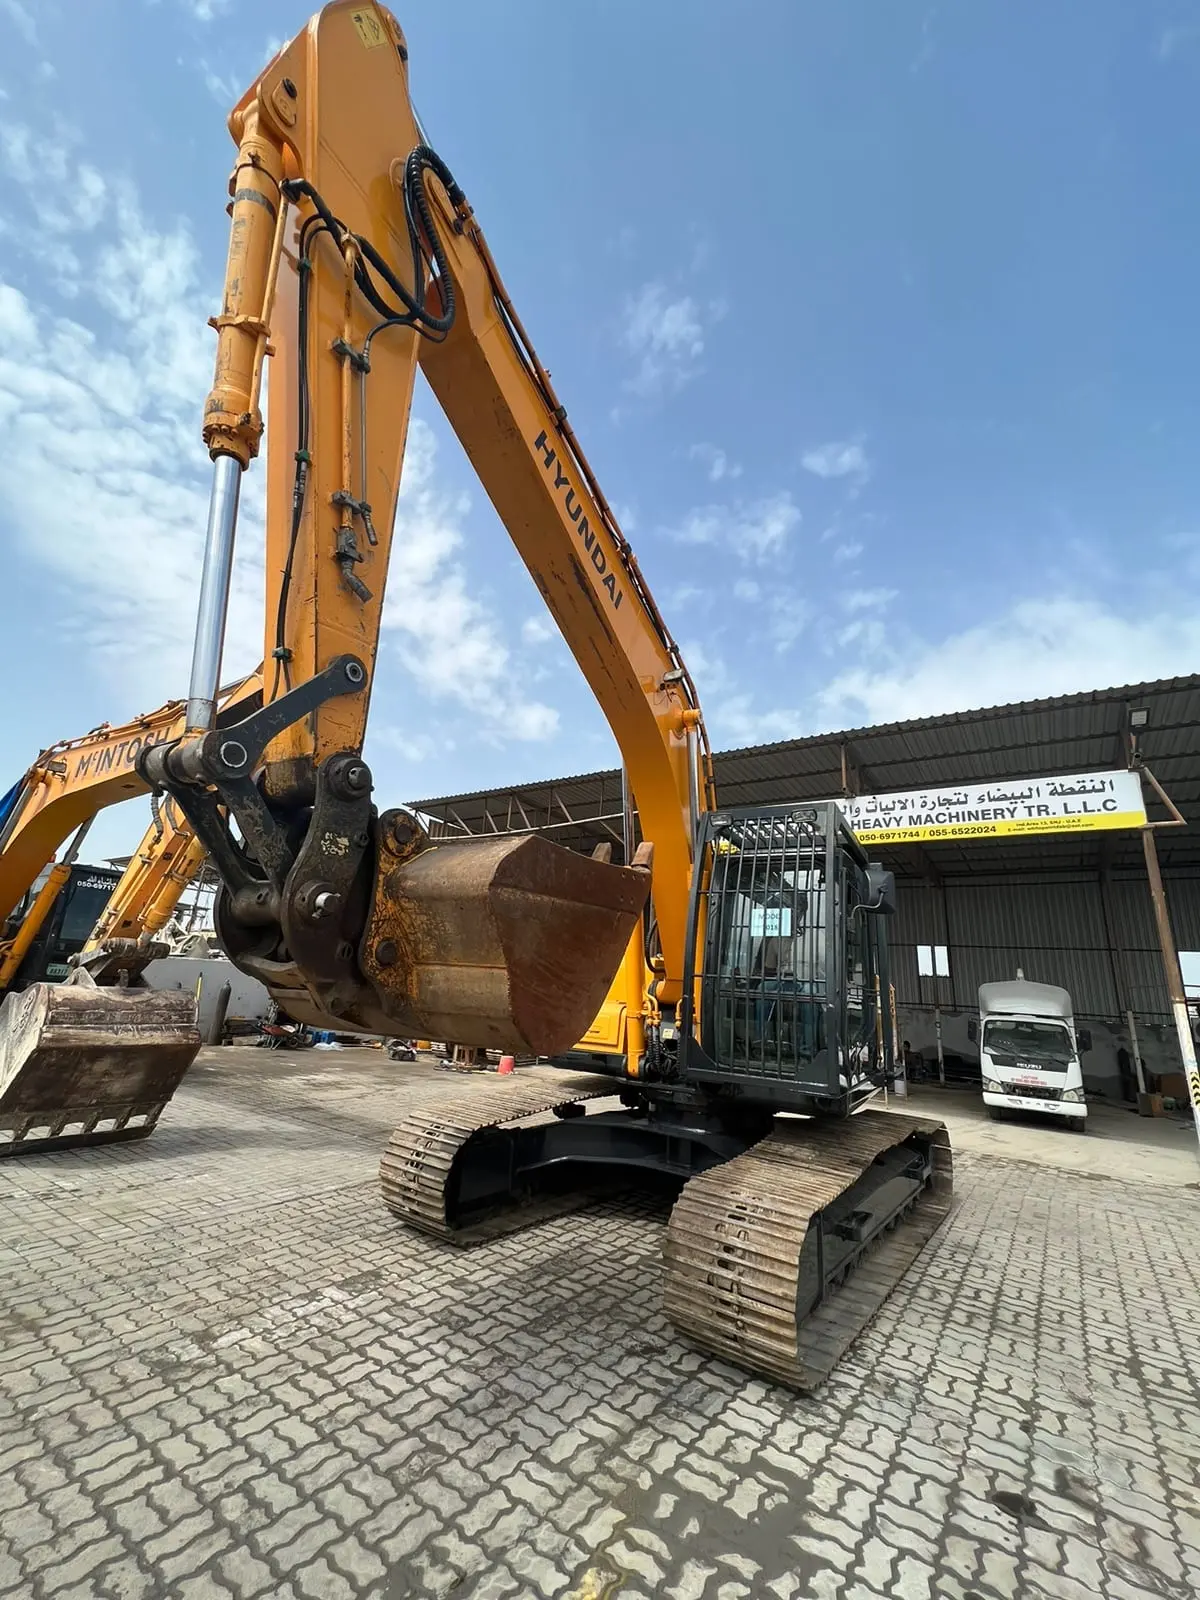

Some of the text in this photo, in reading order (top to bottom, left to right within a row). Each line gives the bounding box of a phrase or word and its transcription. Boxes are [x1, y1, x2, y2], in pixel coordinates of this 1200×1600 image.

[534, 430, 623, 610] HYUNDAI
[976, 786, 1041, 804] البيضاء
[1046, 779, 1114, 797] النقطة
[920, 792, 969, 811] لتجارة
[851, 798, 1117, 830] HEAVY MACHINERY TR. L.L.C
[859, 831, 920, 842] 050-6971744
[929, 825, 997, 837] 055-6522024
